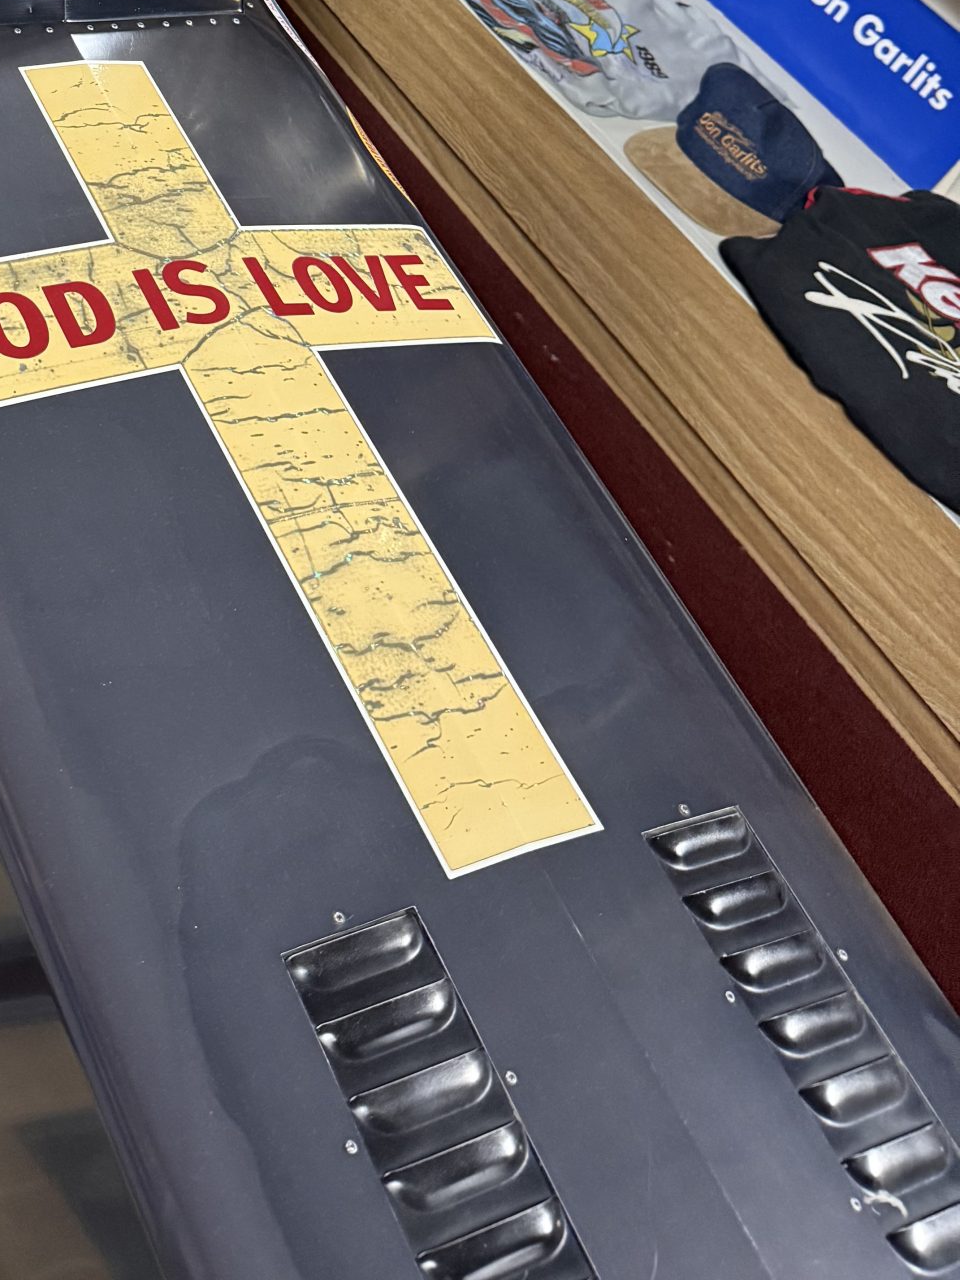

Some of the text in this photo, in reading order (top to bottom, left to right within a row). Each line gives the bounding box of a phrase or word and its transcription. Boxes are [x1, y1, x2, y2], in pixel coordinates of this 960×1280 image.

[853, 13, 954, 112] Garlits
[699, 112, 766, 175] Don Garlits
[131, 258, 231, 332] IS
[240, 253, 453, 317] LOVE
